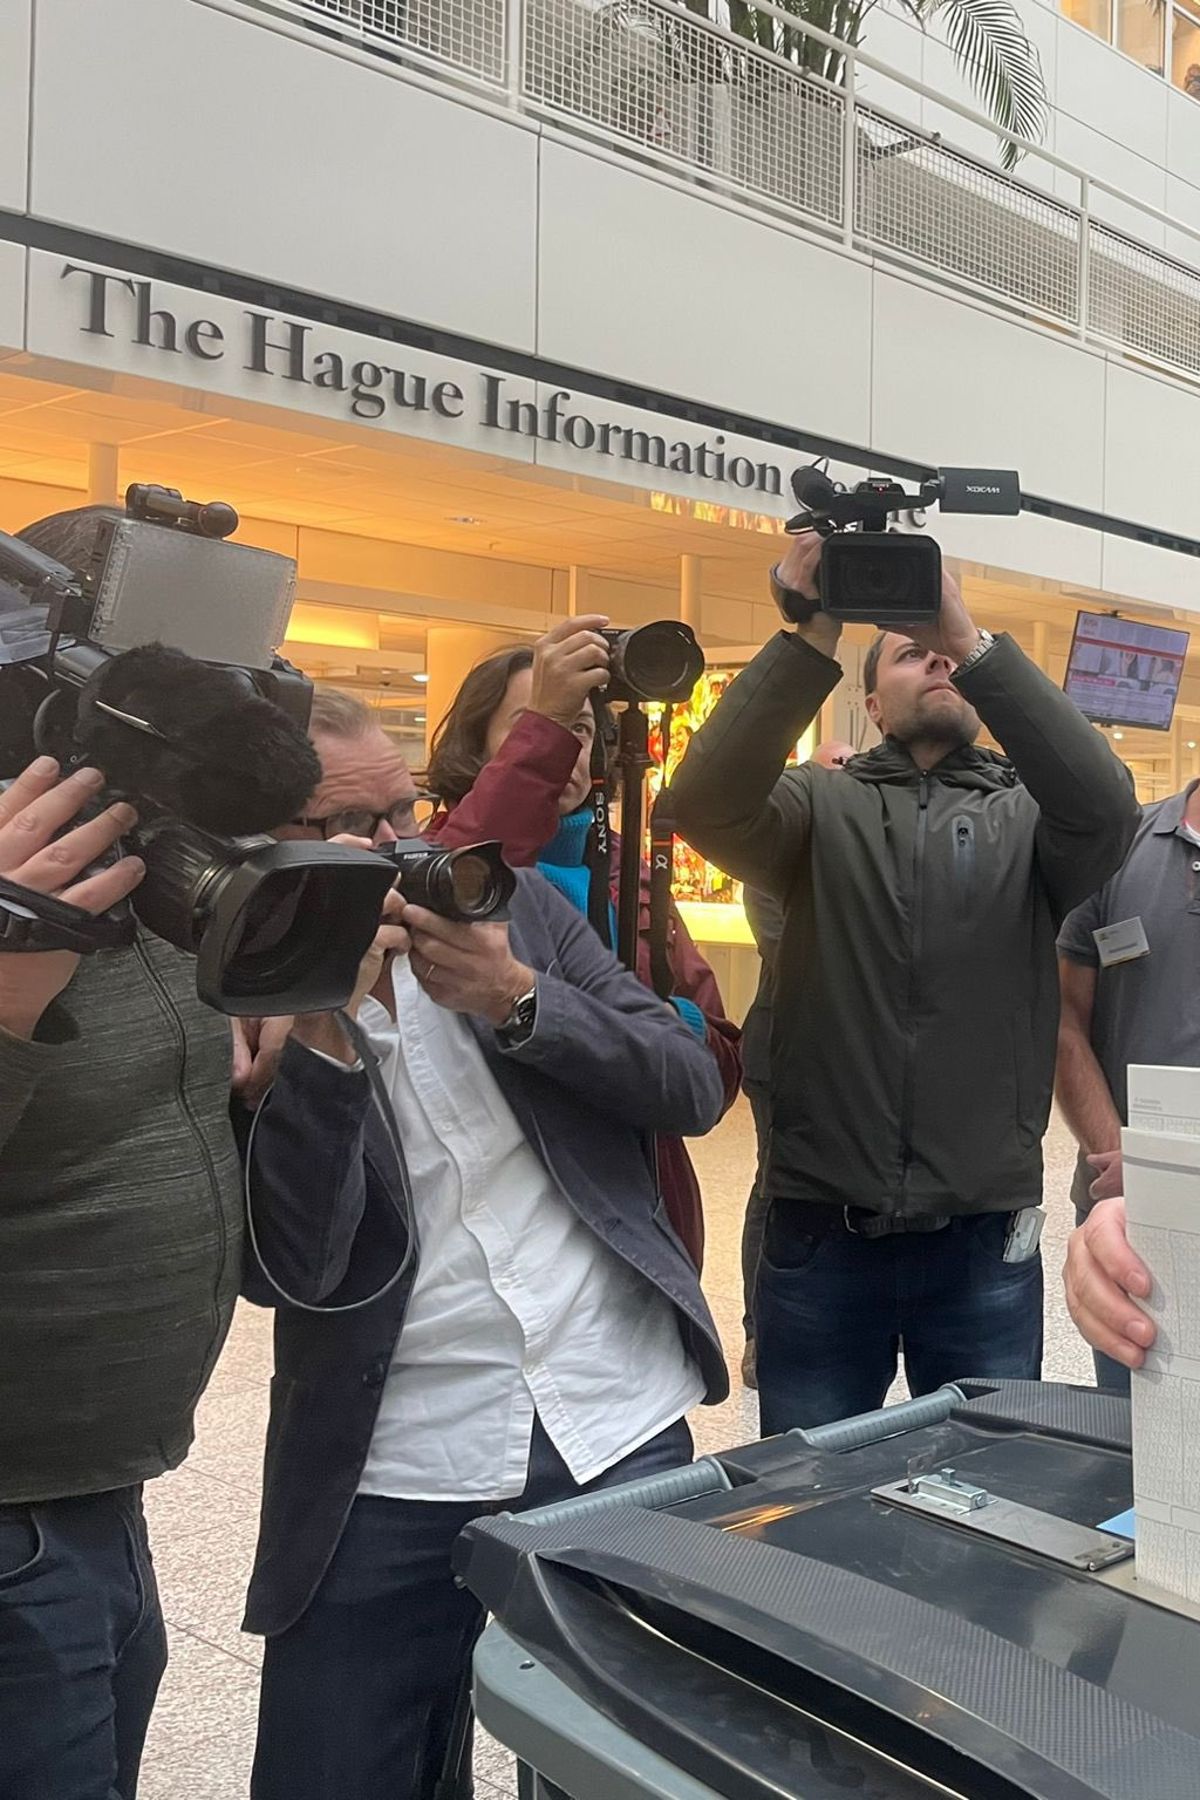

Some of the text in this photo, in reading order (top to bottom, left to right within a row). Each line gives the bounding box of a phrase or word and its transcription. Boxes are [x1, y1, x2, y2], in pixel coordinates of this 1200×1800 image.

[60, 263, 225, 360] The
[243, 310, 465, 418] Hague
[479, 372, 784, 497] Information
[595, 792, 608, 854] SONY
